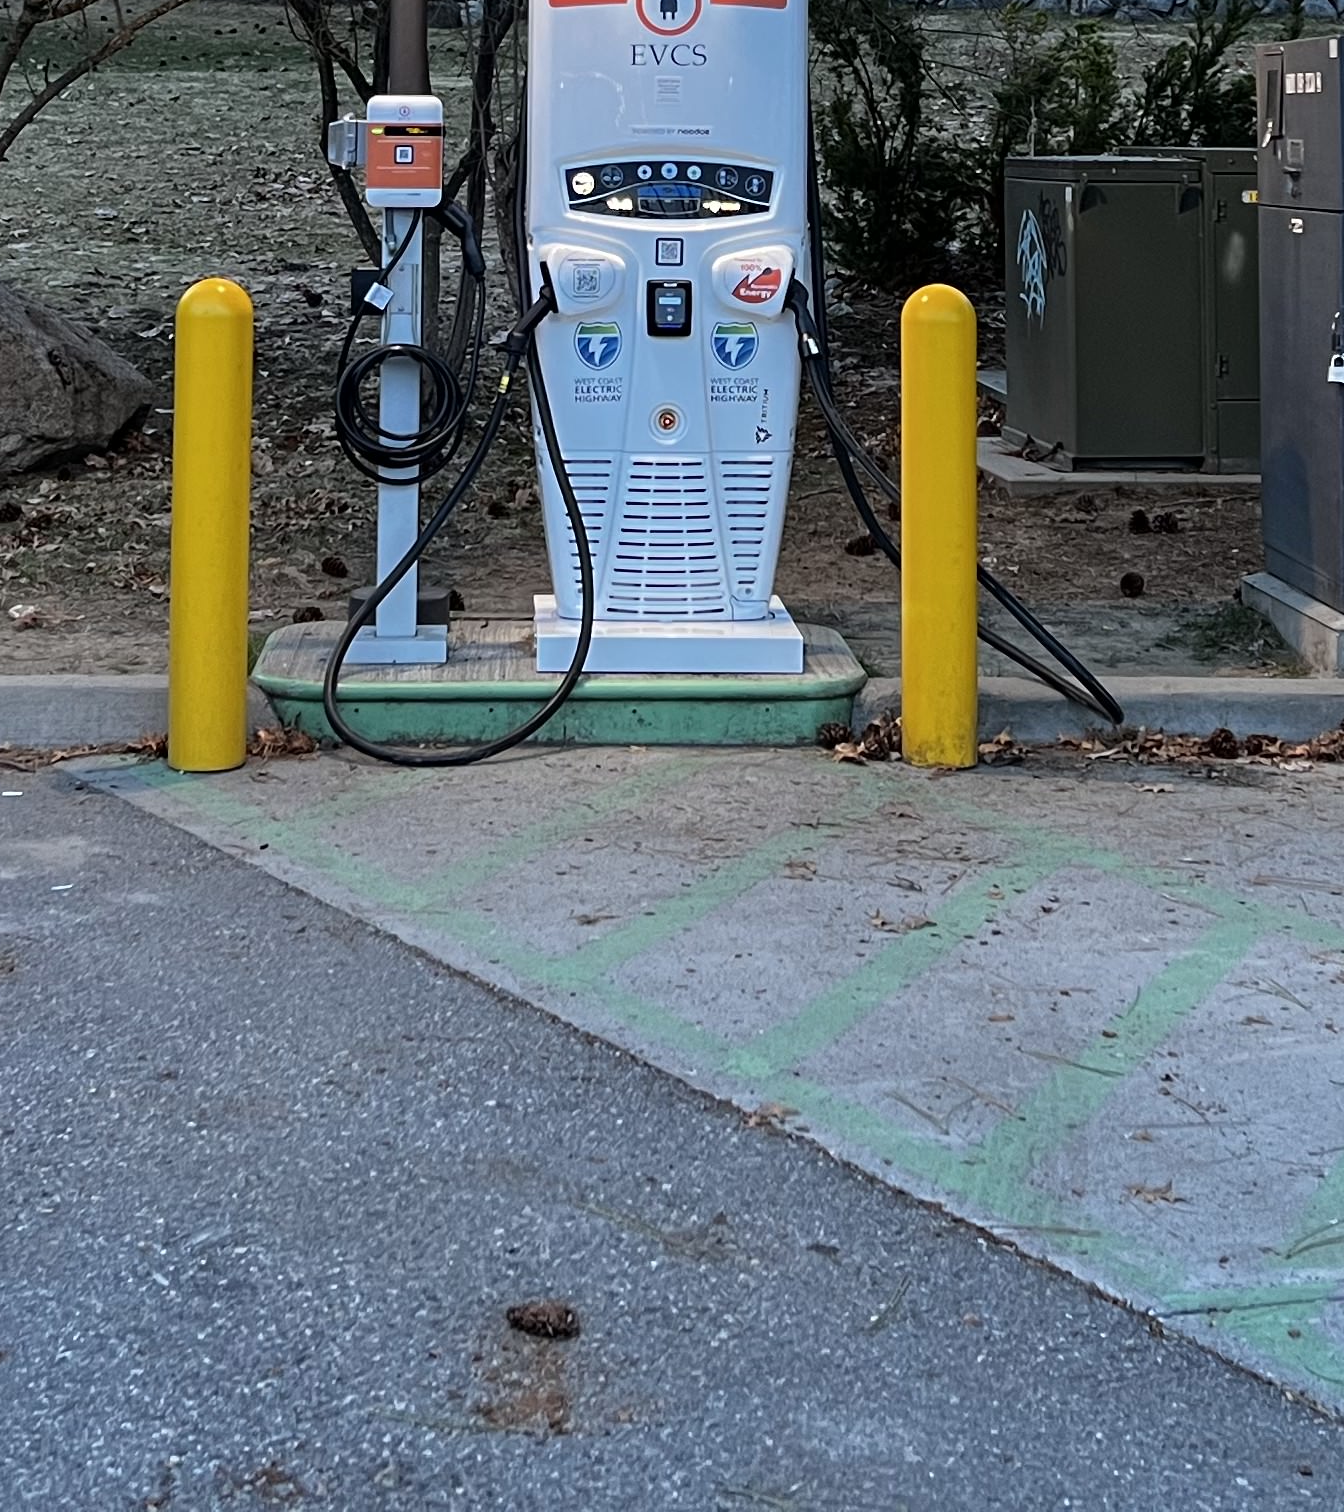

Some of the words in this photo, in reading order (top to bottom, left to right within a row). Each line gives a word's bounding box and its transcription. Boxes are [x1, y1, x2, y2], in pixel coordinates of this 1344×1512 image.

[630, 43, 707, 67] EVCS
[739, 288, 772, 299] Energy
[574, 377, 596, 385] WEST
[598, 377, 623, 385] COAST
[710, 377, 731, 385] WEST
[734, 377, 759, 385] COAST
[574, 385, 622, 394] ELECTRIC
[710, 385, 758, 394] ELECTRIC
[574, 394, 622, 403] HIGHWAY
[710, 394, 758, 403] HIGHWAY
